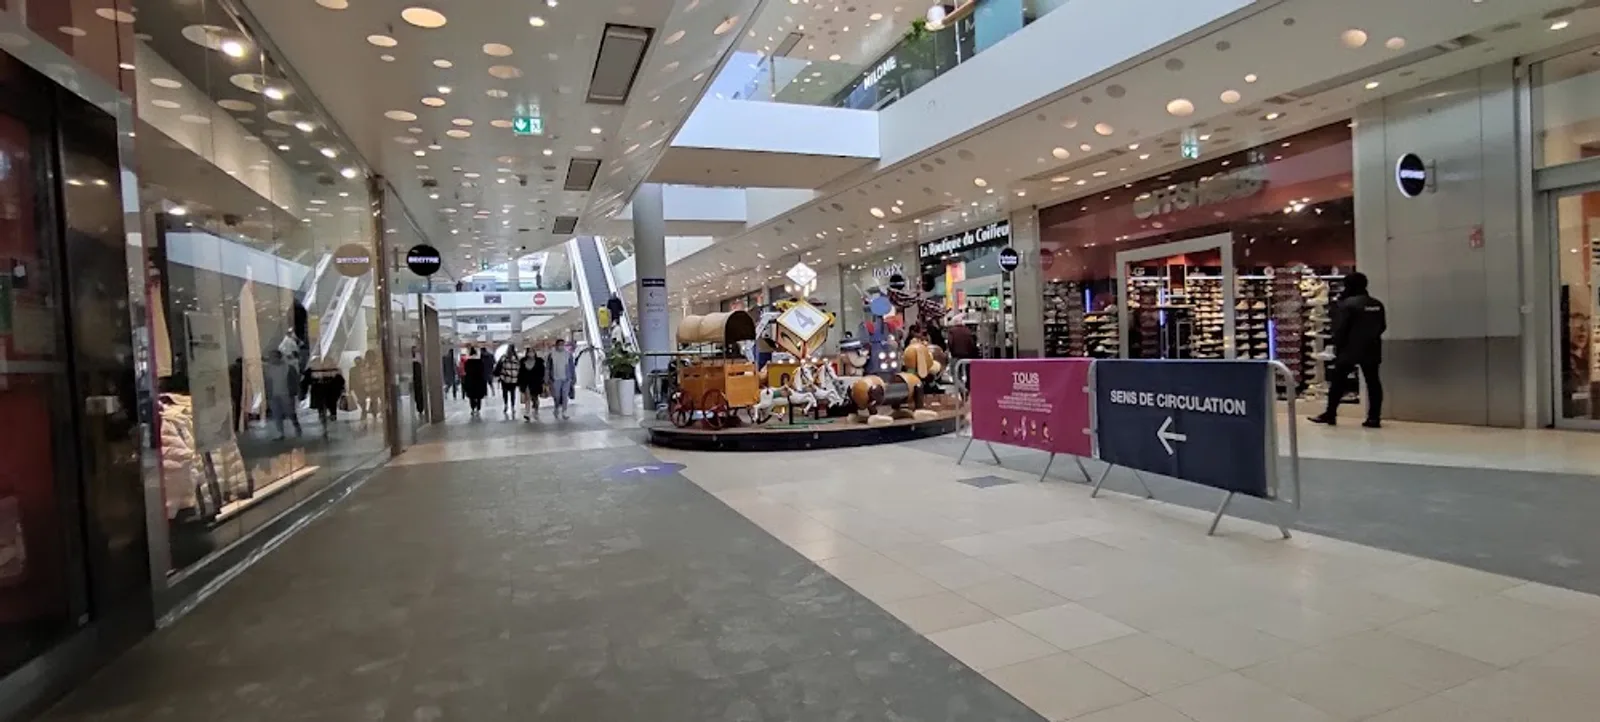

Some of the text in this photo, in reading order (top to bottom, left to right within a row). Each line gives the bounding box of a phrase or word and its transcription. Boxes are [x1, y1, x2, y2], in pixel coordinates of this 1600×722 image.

[920, 244, 929, 258] La
[929, 237, 961, 256] Boutique
[963, 231, 974, 246] du
[1012, 372, 1040, 384] TOUS
[1110, 389, 1246, 416] SENS DE CIRCULATION
